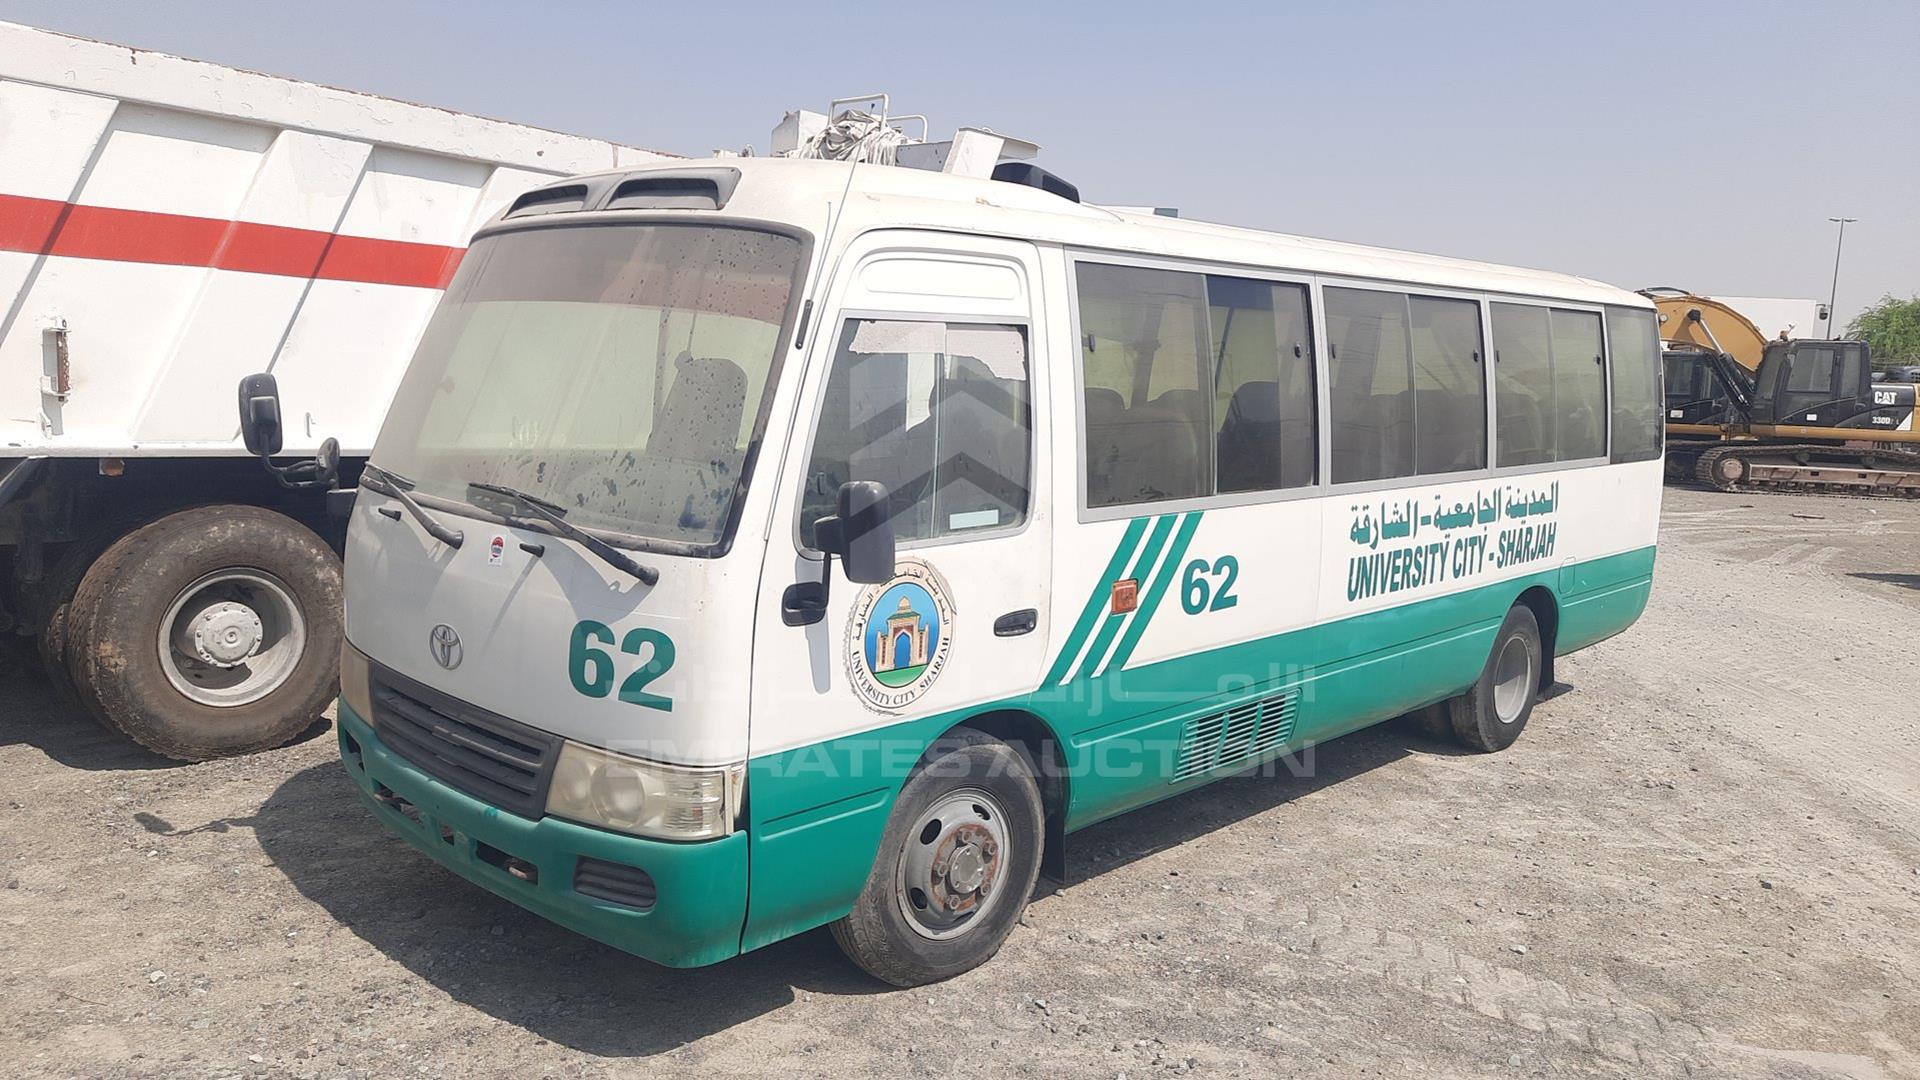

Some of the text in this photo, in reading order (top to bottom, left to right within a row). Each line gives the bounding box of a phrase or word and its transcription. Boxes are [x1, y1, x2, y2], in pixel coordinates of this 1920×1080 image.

[1874, 391, 1897, 405] CAT
[1350, 499, 1418, 550] الشارقة
[1434, 487, 1501, 538] الجامعية
[1505, 480, 1559, 525] المدينة
[1181, 555, 1239, 615] 62
[1347, 541, 1450, 601] UNIVERSITY
[1453, 534, 1488, 579] CITY
[1497, 522, 1557, 569] SHARJAH
[568, 619, 676, 712] 62
[852, 650, 892, 705] UNIVERSITY
[893, 688, 916, 705] CITY
[919, 637, 949, 691] SHARJAH
